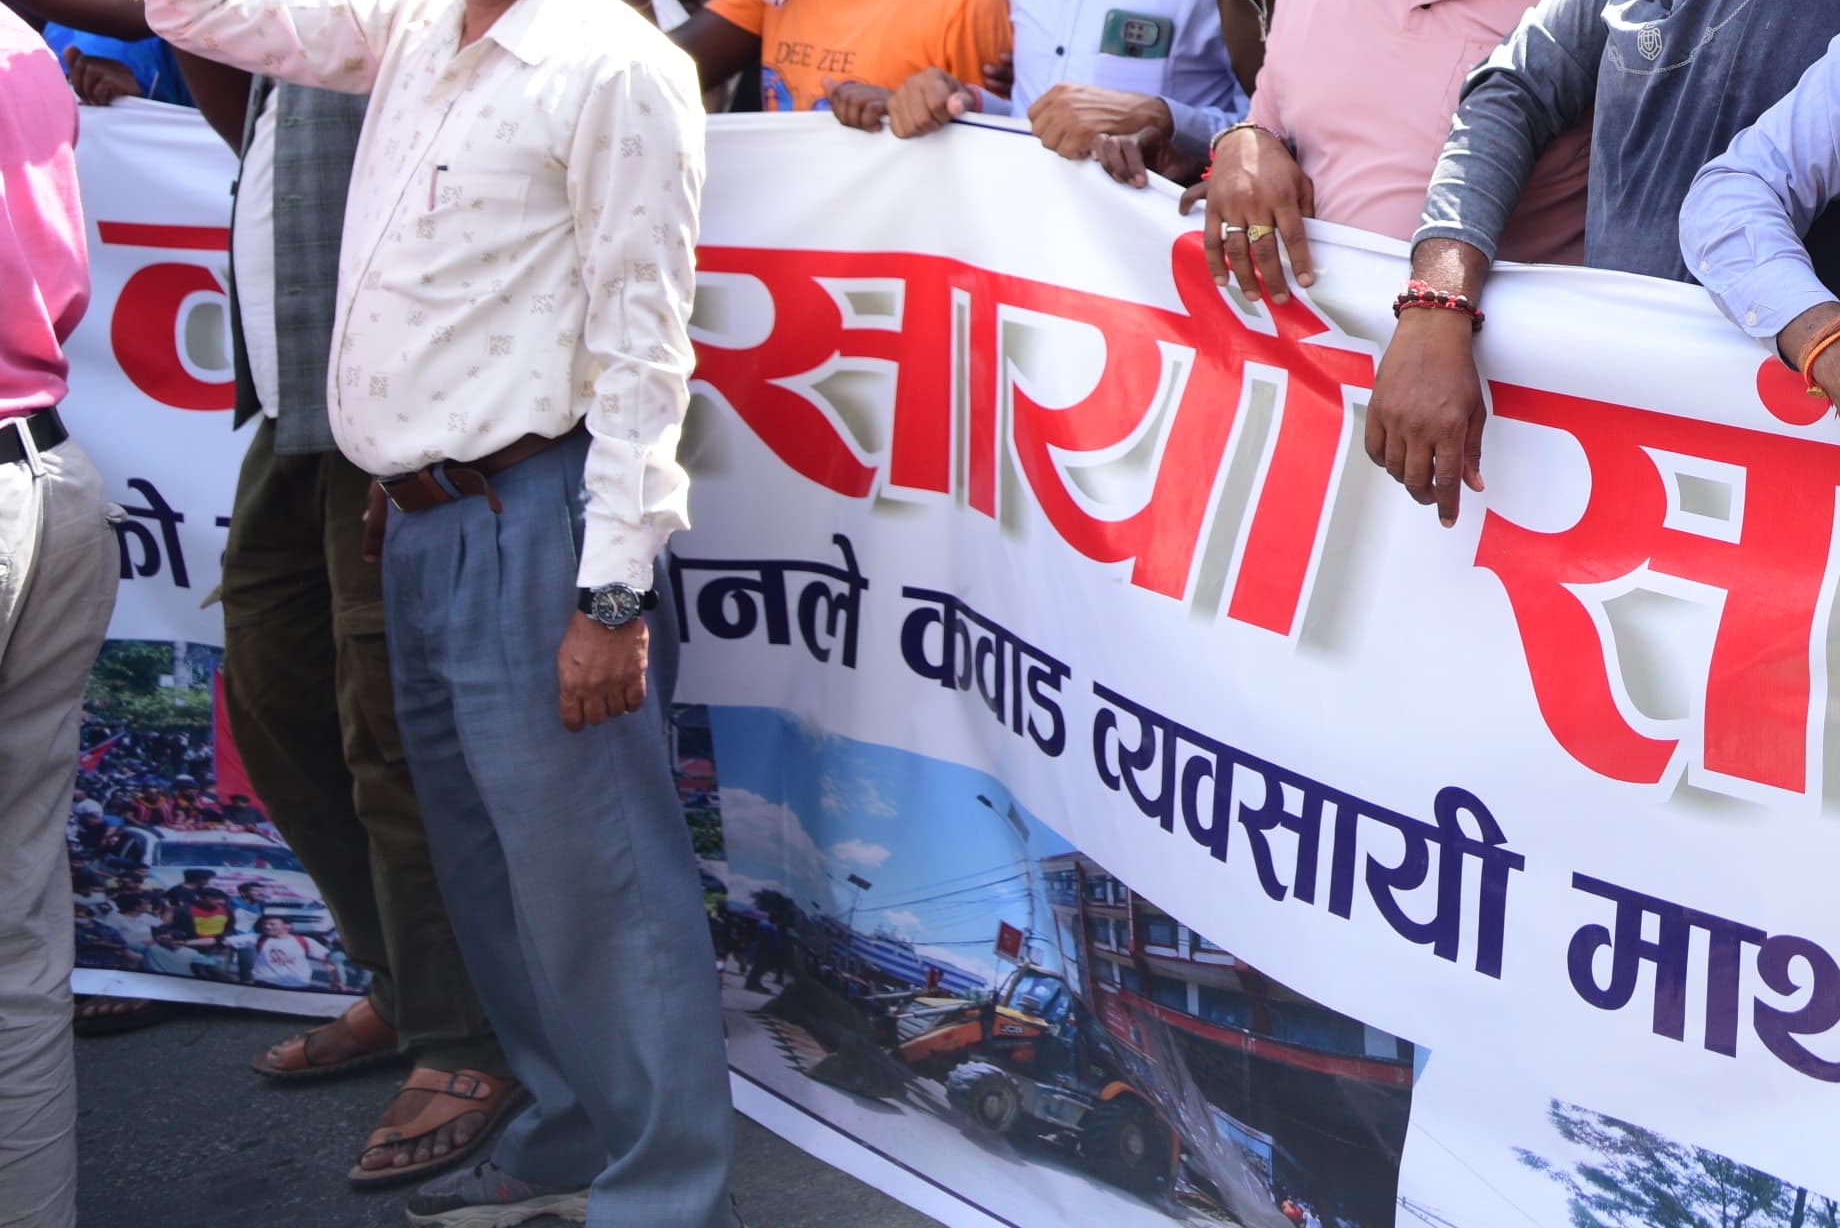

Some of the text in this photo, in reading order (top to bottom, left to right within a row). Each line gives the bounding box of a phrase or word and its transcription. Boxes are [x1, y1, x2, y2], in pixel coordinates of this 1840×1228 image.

[774, 40, 857, 74] DEE ZEE
[901, 585, 1071, 758] कवाड
[1093, 681, 1525, 980] व्यवसायी
